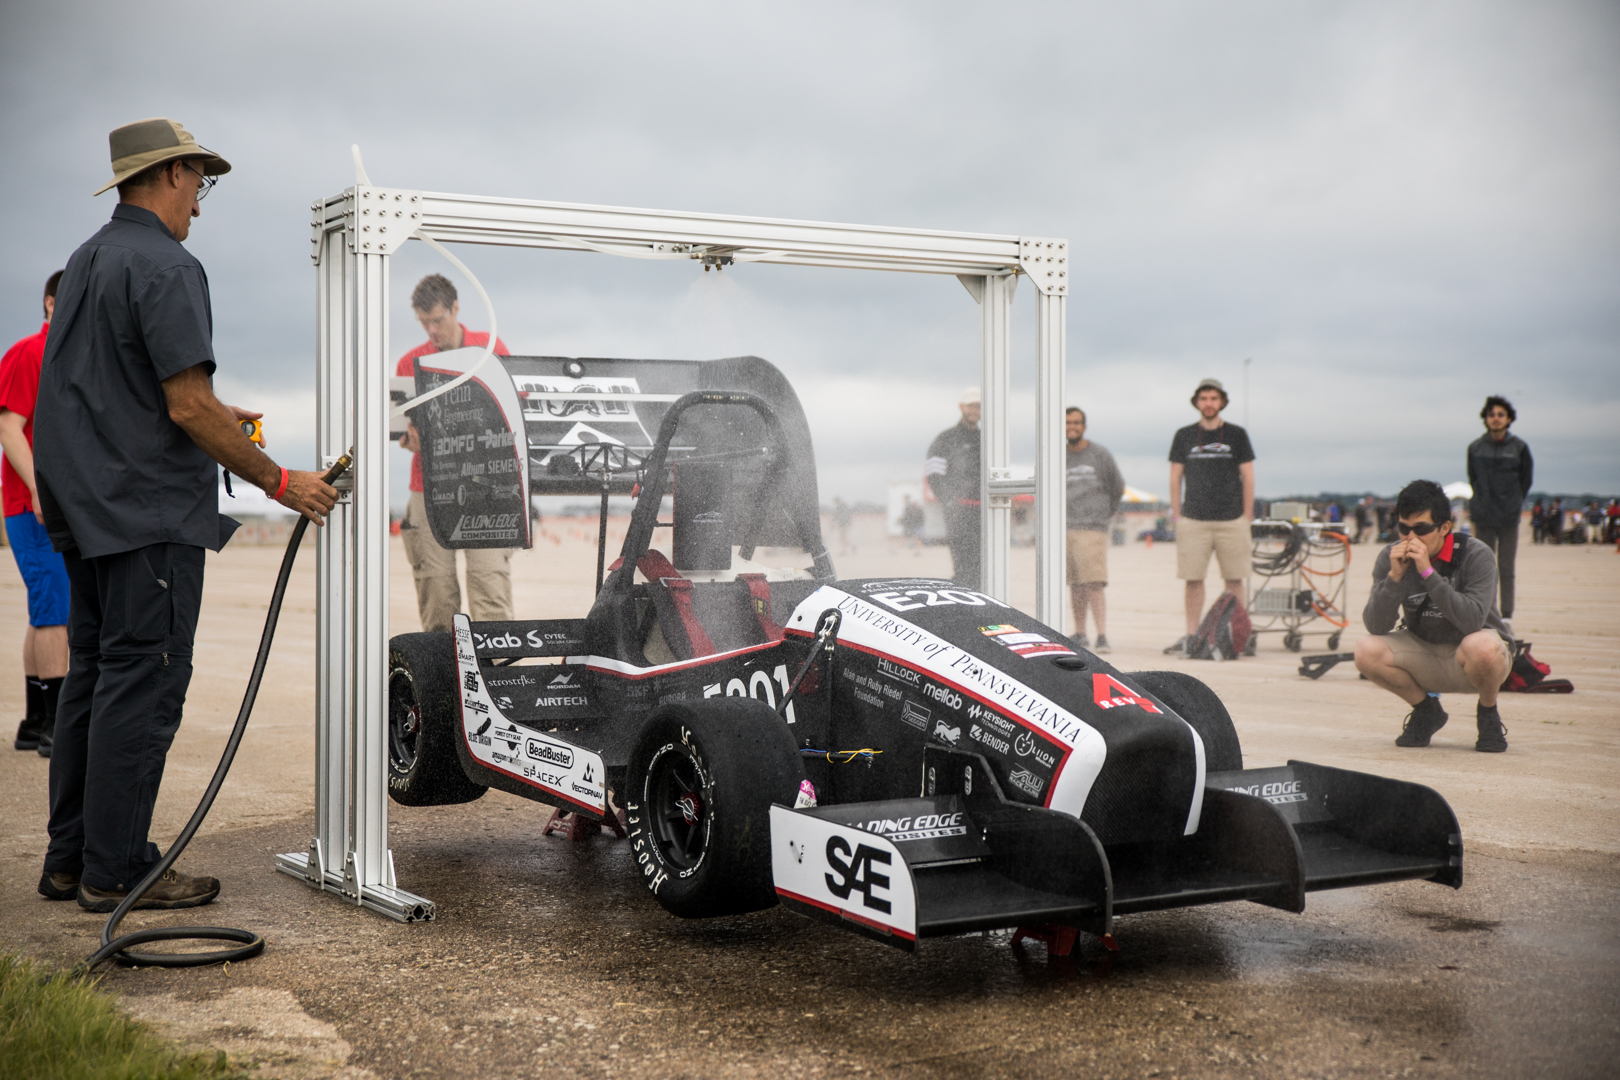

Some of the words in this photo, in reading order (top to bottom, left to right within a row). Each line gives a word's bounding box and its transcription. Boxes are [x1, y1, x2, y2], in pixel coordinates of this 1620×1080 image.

[444, 405, 484, 431] Engineering
[485, 427, 517, 449] Parker
[488, 458, 524, 475] SIEMENS
[460, 514, 497, 529] LEADING
[496, 513, 521, 528] EDGE
[461, 530, 516, 540] COMPOSITES
[869, 590, 1012, 612] E201
[455, 625, 470, 639] HESSE
[458, 652, 475, 662] SMART
[837, 596, 927, 647] UNIVERSITY
[923, 644, 954, 661] of
[950, 654, 1081, 743] PENNSYLVANIA
[877, 657, 921, 684] HILLOCK
[843, 667, 856, 680] Alan
[856, 674, 867, 686] and
[867, 677, 883, 694] Ruby
[883, 684, 903, 700] Riedel
[535, 696, 588, 707] AIRTECH
[854, 687, 885, 709] Foundation
[923, 683, 963, 710] mellab
[1100, 697, 1136, 709] REV
[980, 718, 1011, 738] TECHNOLOGIES
[982, 710, 1016, 733] KEYSIGHT
[529, 742, 571, 765] BeadBuster
[981, 732, 1010, 755] BENDER
[523, 767, 569, 787] SPACEX
[1262, 780, 1302, 796] EDGE
[571, 781, 603, 800] VECTORNAV
[847, 816, 912, 834] DING
[913, 812, 963, 830] EDGE
[891, 828, 963, 840] OSITES
[824, 835, 892, 916] SAE
